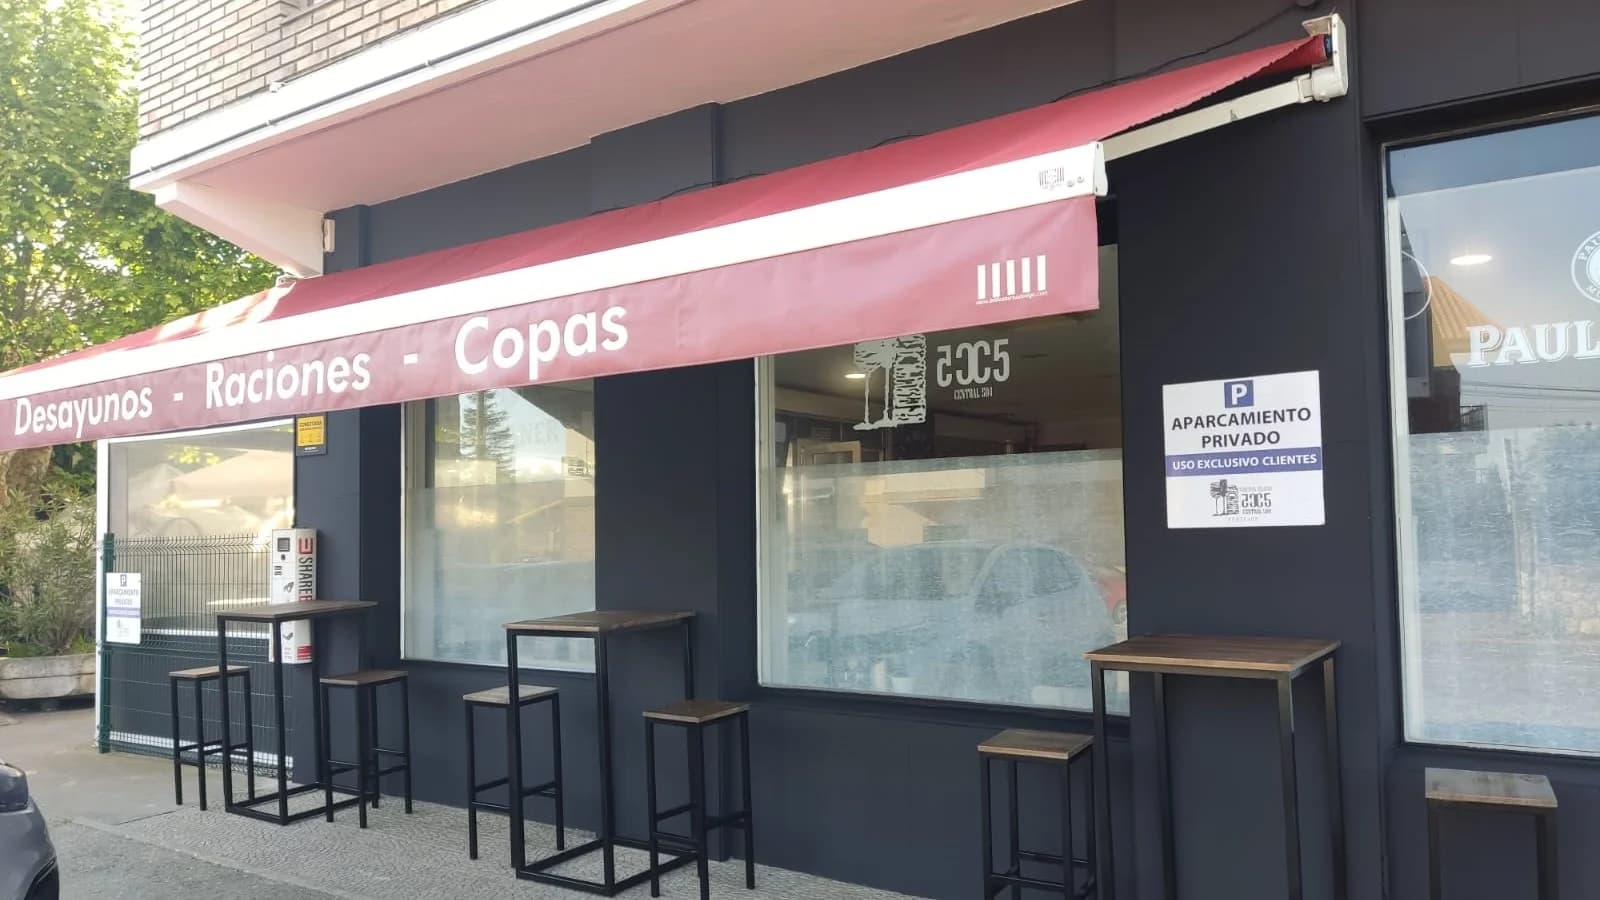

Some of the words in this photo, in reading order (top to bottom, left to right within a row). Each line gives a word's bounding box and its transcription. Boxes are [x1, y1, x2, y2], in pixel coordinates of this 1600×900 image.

[14, 386, 153, 438] Desayunos
[205, 351, 371, 410] Raciones
[454, 305, 629, 381] Copas
[1171, 407, 1312, 431] APARCAMIENTO
[1202, 431, 1281, 449] PRIVADO
[1172, 460, 1195, 471] USO
[1197, 456, 1259, 469] EXCLUSIVO
[1262, 453, 1318, 466] CLIENTES
